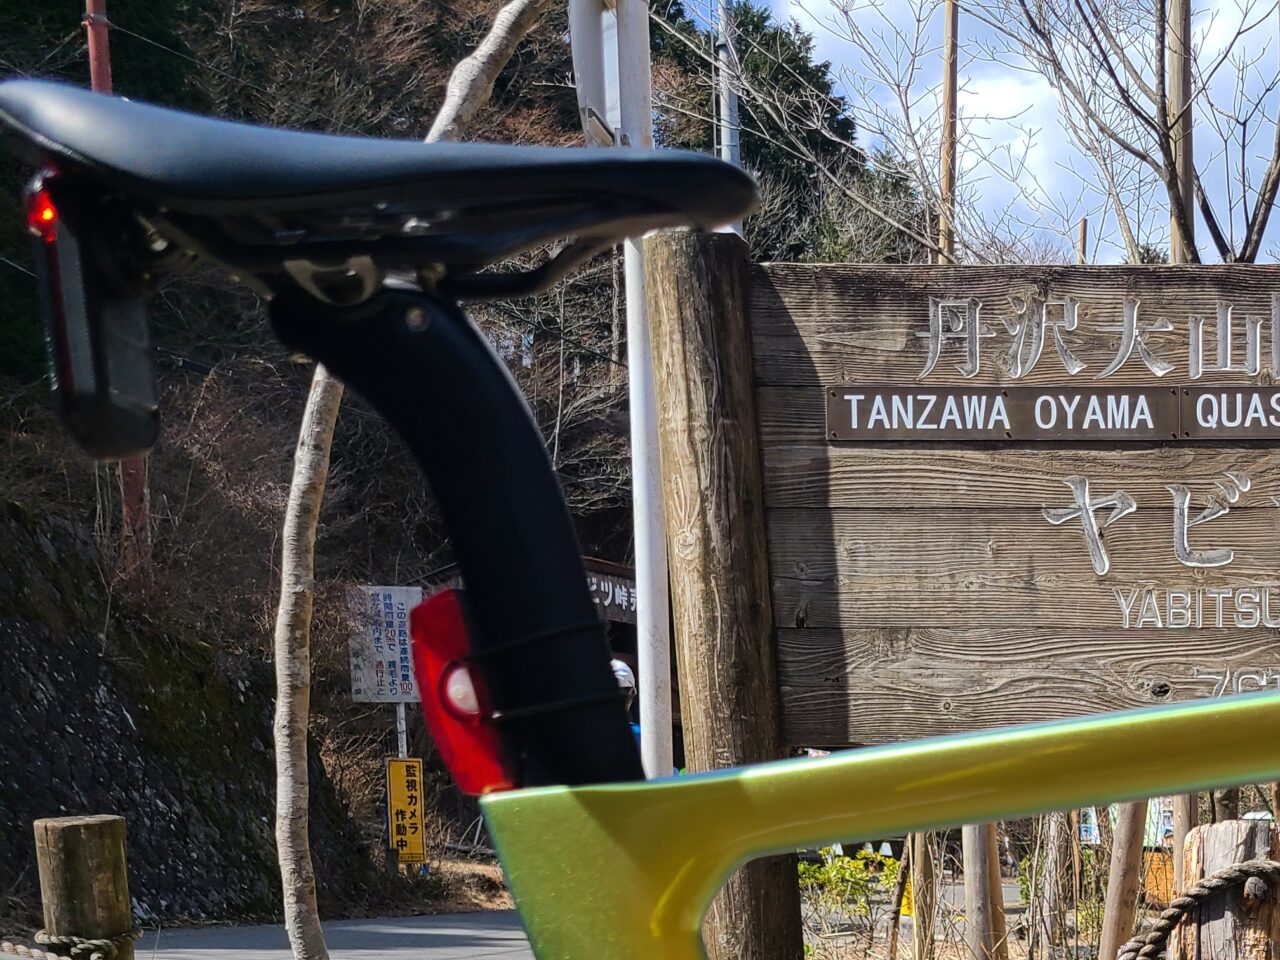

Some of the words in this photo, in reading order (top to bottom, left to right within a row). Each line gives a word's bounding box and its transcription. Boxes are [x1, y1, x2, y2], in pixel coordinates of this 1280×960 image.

[843, 394, 1011, 430] TANZAWA
[1034, 394, 1155, 430] OYAMA
[405, 764, 419, 836] 監視カメラ
[395, 808, 408, 851] 作動中
